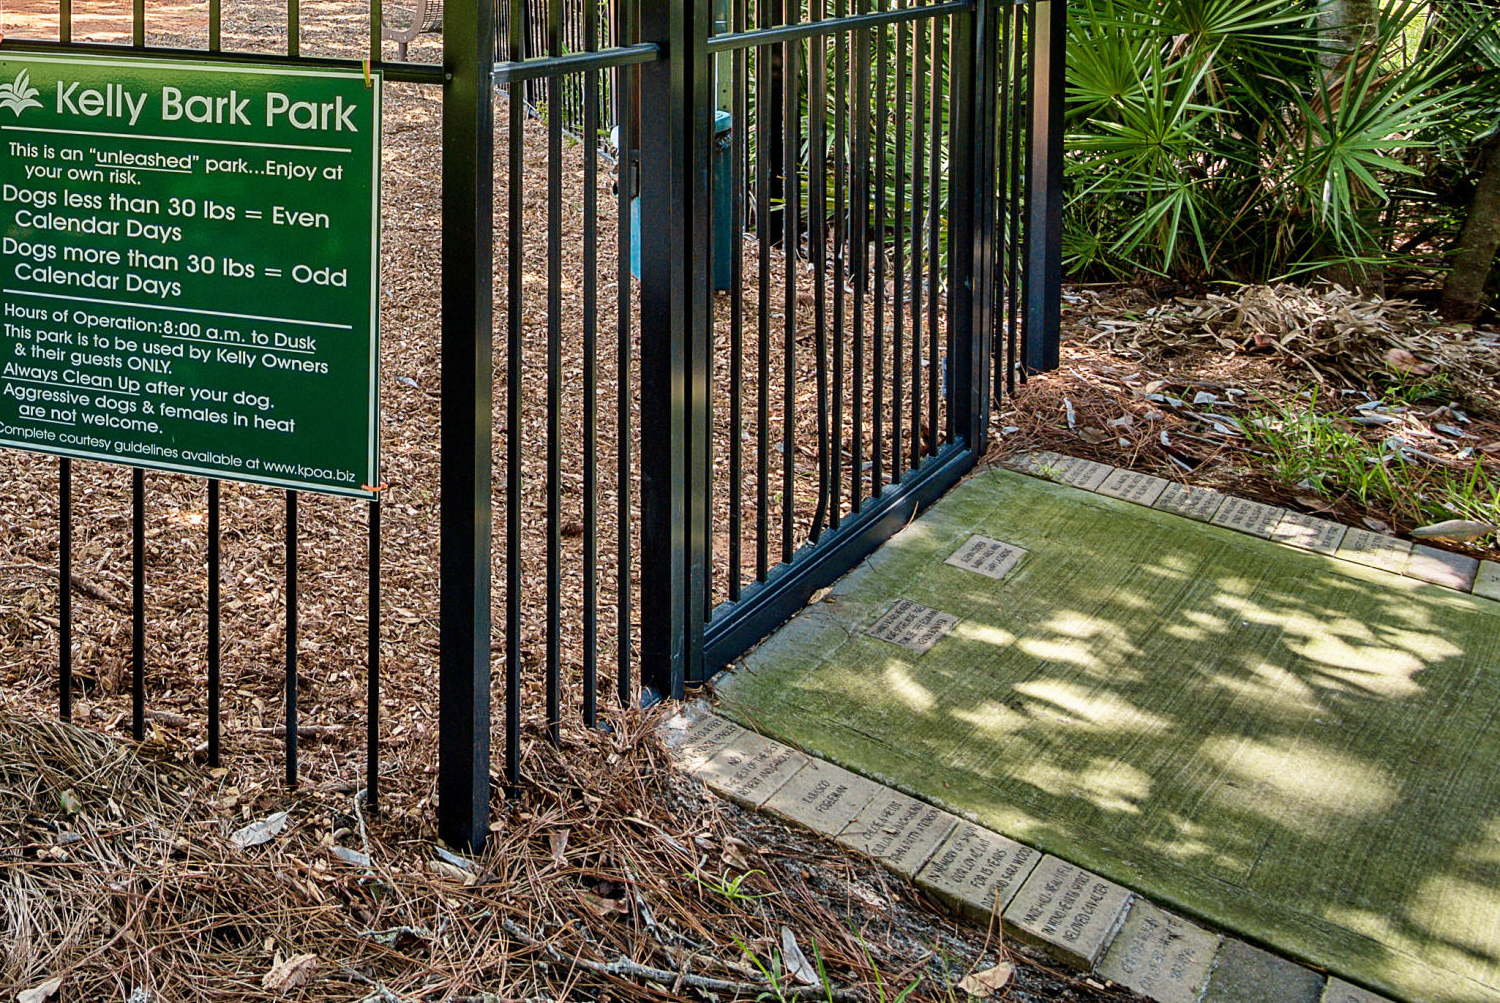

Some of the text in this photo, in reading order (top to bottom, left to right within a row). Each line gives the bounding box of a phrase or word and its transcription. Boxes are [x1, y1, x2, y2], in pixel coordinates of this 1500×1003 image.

[56, 80, 359, 132] Kelly Bark Park
[8, 141, 39, 158] This
[43, 144, 56, 159] is
[60, 148, 84, 162] an
[322, 165, 343, 180] at
[24, 165, 141, 185] your own risk.
[3, 183, 57, 209] Dogs
[64, 189, 102, 210] less
[108, 192, 160, 215] than
[167, 197, 196, 218] 30
[203, 200, 236, 221] lbs
[272, 205, 330, 229] Even
[15, 209, 182, 244] Calendar Days
[2, 236, 57, 262] Dogs
[63, 246, 121, 265] more
[127, 248, 179, 271] than
[186, 254, 215, 275] 30
[223, 257, 255, 279] lbs
[291, 264, 347, 287] Odd
[14, 262, 182, 299] Calendar Days
[4, 302, 48, 321] Hours
[52, 309, 69, 323] of
[205, 327, 245, 343] a.m.
[251, 329, 269, 345] to
[274, 332, 317, 351] Dusk
[3, 323, 329, 374] This park is to be used by Kelly Owners
[14, 342, 172, 375] & their guests ONLY.
[3, 361, 274, 411] Always Clean Up after your dog.
[3, 382, 296, 433] Aggressive dogs & females in heat
[18, 404, 163, 434] are not welcome.
[58, 433, 112, 451] courtesy
[113, 441, 179, 459] guidelines
[181, 450, 243, 467] available
[245, 458, 260, 470] at
[263, 461, 356, 483] www.kpoa.biz
[748, 761, 758, 770] OF
[754, 752, 771, 763] THE
[802, 780, 831, 804] TABASCO
[816, 785, 849, 813] FOGLEMAN
[929, 871, 942, 883] IN
[934, 850, 958, 875] MEMORY
[951, 868, 970, 883] OUR
[961, 848, 984, 871] LOYAL
[971, 849, 1008, 889] FOR 15 YEARS
[1002, 864, 1021, 882] SARA
[1013, 846, 1034, 866] WOOD
